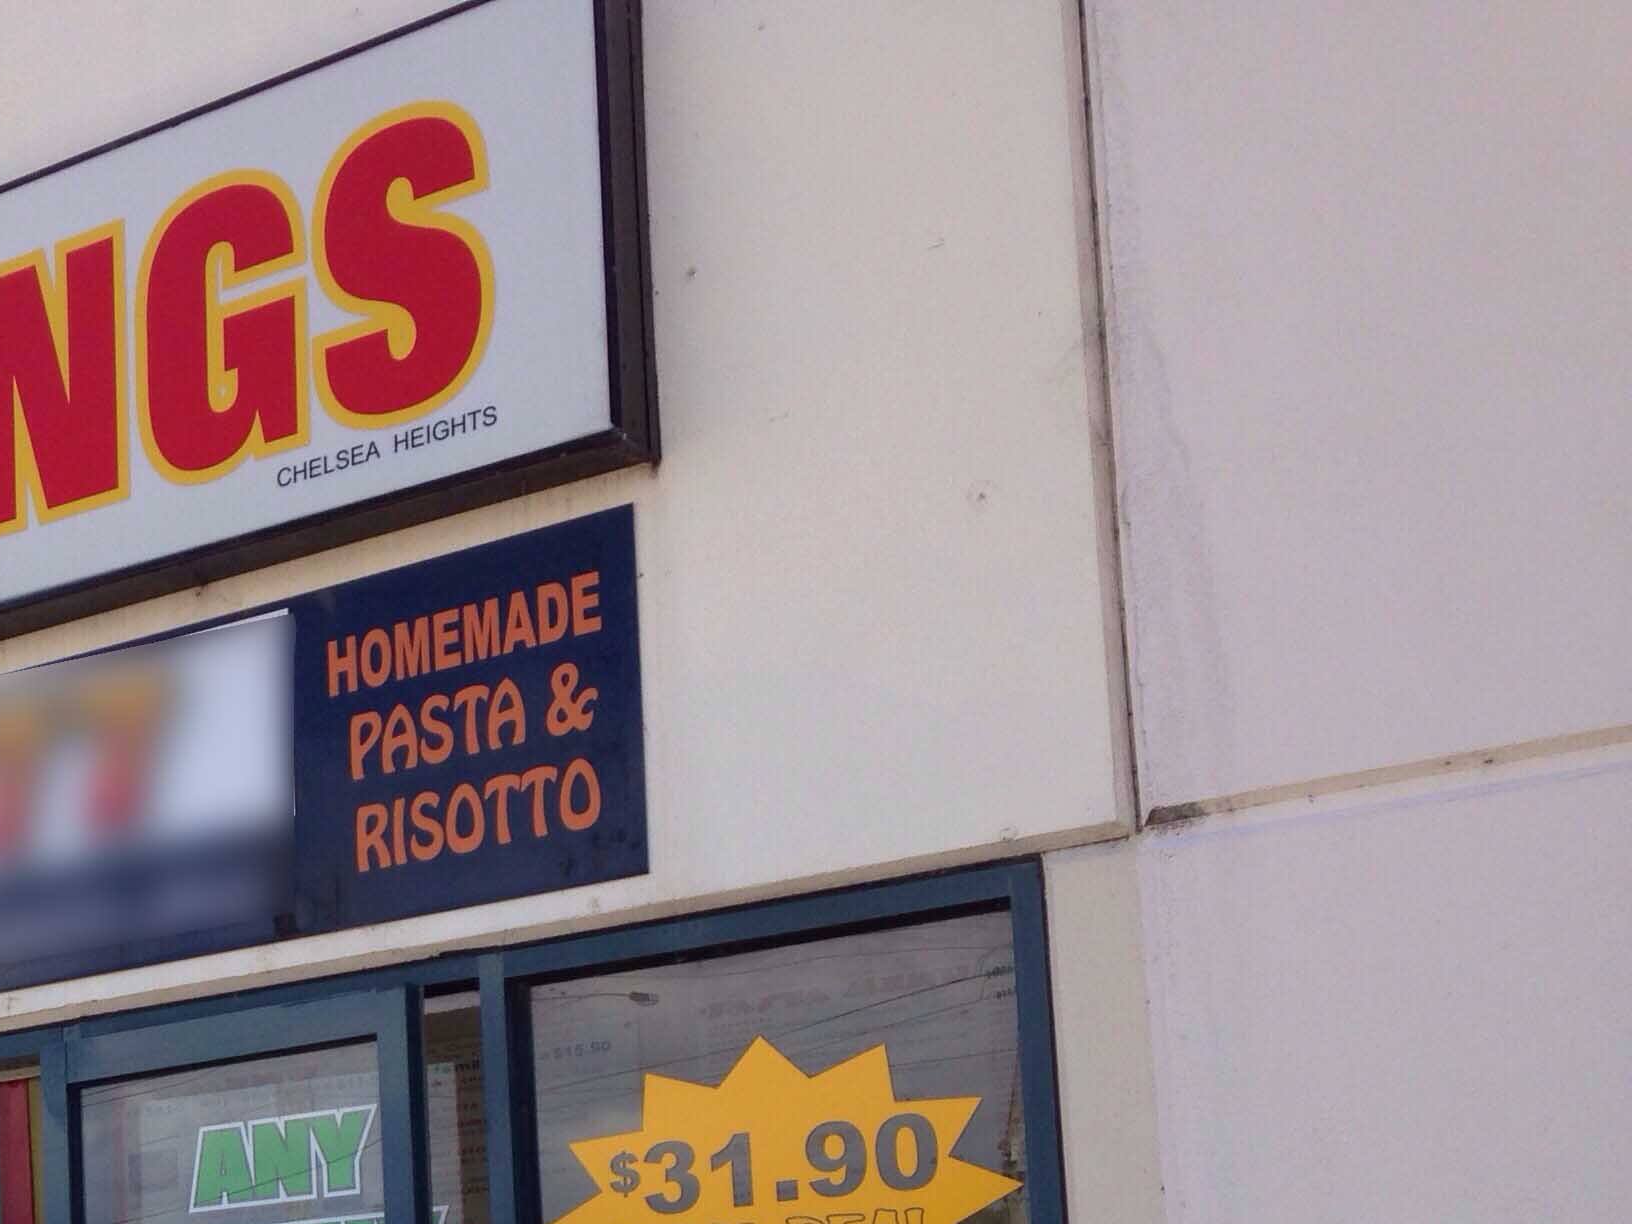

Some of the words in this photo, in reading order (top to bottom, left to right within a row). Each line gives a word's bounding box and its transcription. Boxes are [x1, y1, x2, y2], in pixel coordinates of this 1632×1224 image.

[276, 440, 381, 488] CHELSEA
[393, 405, 498, 454] HEIGHTS
[326, 570, 603, 698] HOMEMADE
[348, 676, 527, 780] PASTA
[546, 661, 599, 737] &
[354, 757, 602, 872] RISOTTO
[189, 1103, 377, 1214] ANY
[608, 1111, 940, 1215] $31.90
